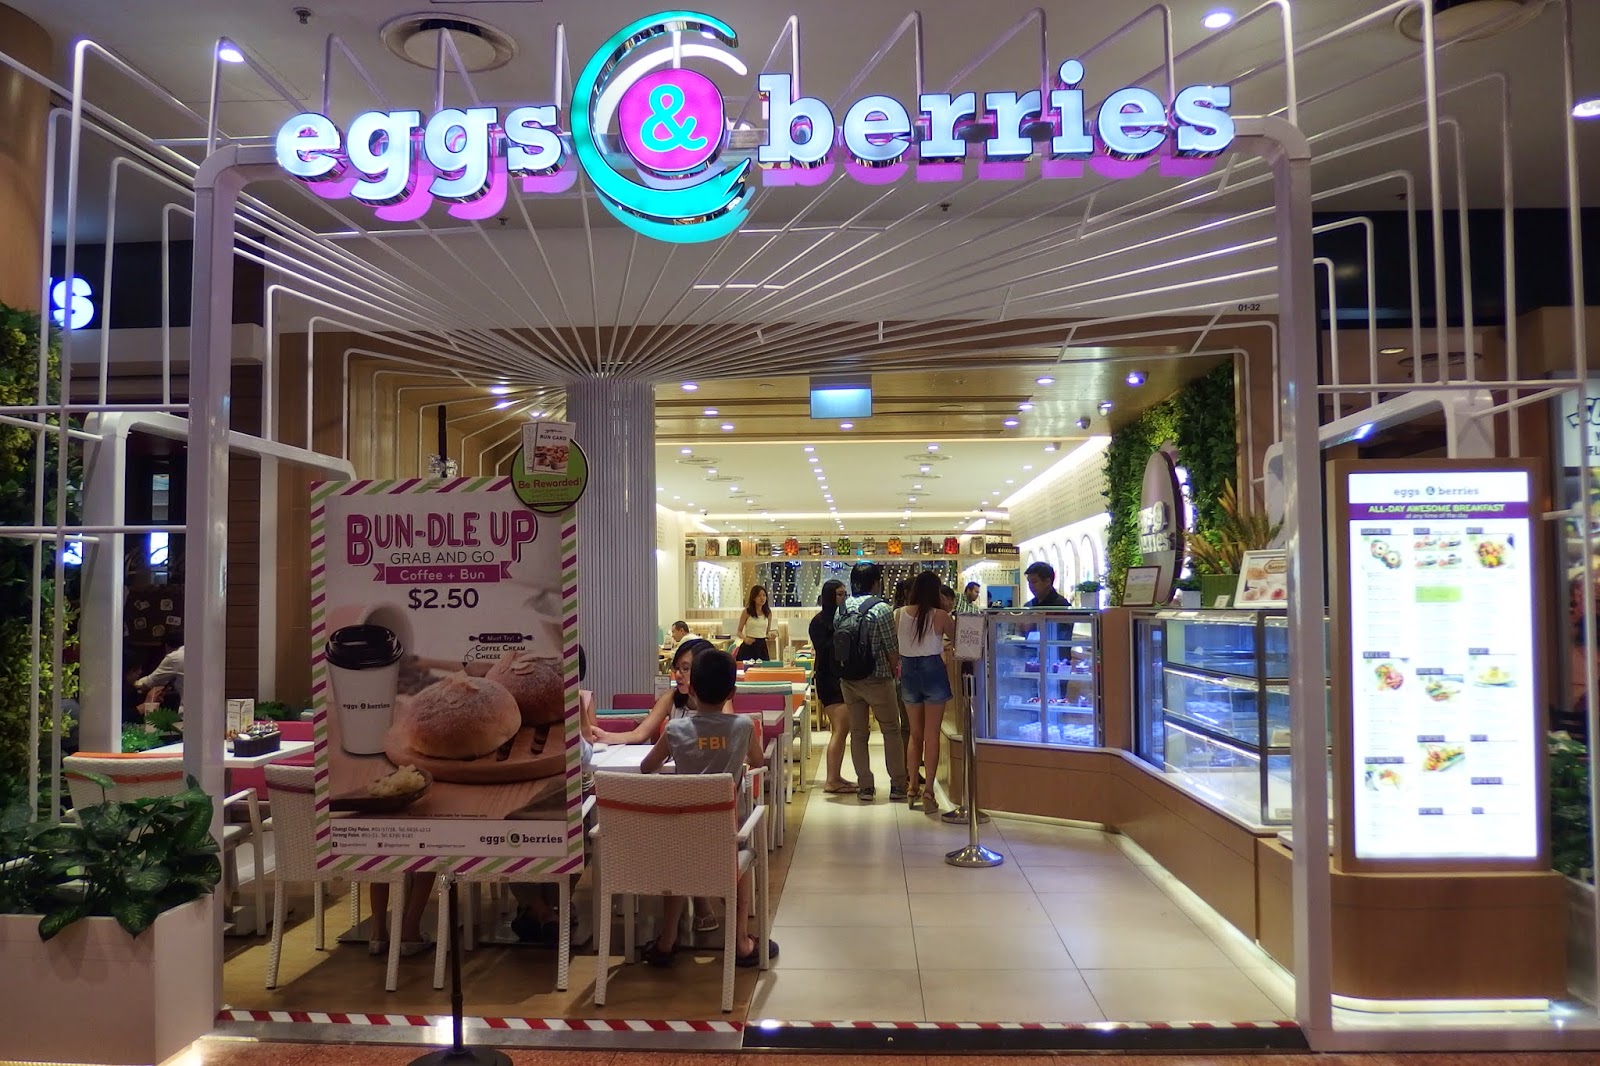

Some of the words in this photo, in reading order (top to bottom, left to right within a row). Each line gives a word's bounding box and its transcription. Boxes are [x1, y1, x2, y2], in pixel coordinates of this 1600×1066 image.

[275, 105, 563, 204] eggs
[640, 84, 708, 152] &
[758, 59, 1236, 166] berries
[1238, 303, 1261, 311] 01-32
[518, 480, 531, 489] Be
[533, 477, 582, 488] Rewarded!
[1394, 487, 1420, 497] eggs
[1438, 486, 1479, 495] berries
[1368, 505, 1405, 513] ALL-DAY
[1406, 504, 1451, 512] AWESOME
[1452, 503, 1505, 512] BREAKFAST
[347, 512, 480, 566] BUN-DLE
[490, 510, 538, 563] UP
[390, 552, 431, 564] GRAB
[435, 551, 467, 564] AND
[471, 550, 495, 563] GO
[400, 569, 443, 581] Coffee
[448, 572, 455, 580] +
[460, 569, 485, 580] Bun
[408, 587, 479, 611] $2.50
[698, 736, 726, 750] FBI
[480, 834, 505, 845] eggs
[522, 834, 563, 843] berries
